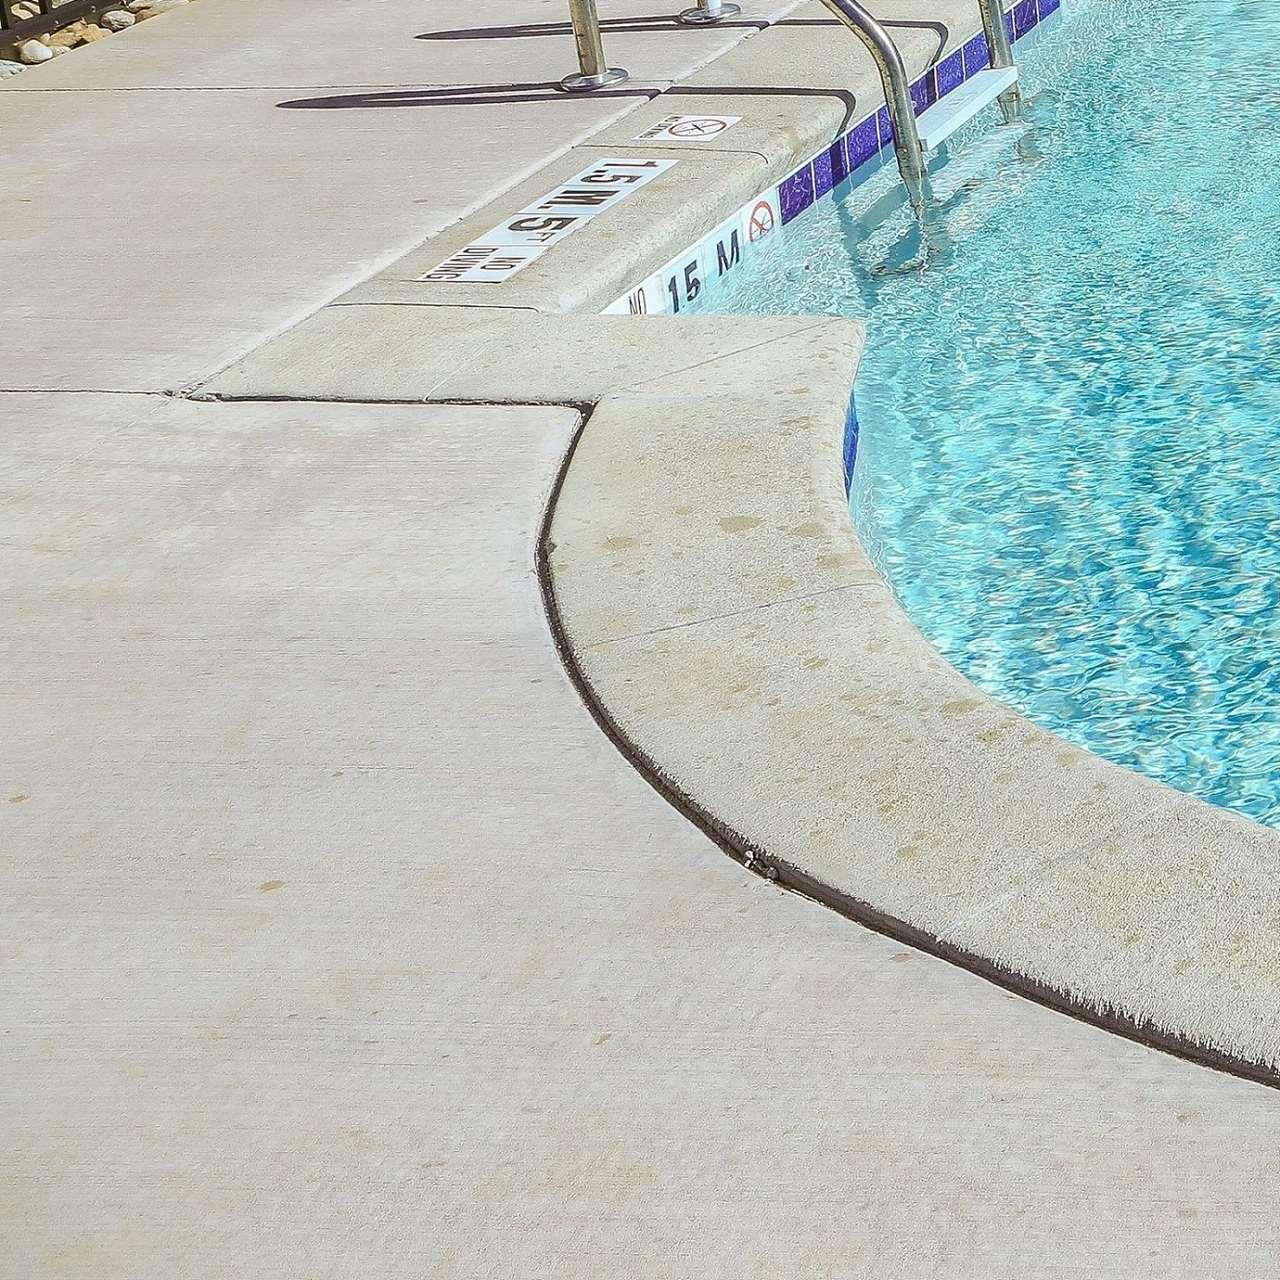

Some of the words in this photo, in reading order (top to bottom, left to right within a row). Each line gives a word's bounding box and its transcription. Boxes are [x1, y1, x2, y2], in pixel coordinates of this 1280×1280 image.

[580, 160, 659, 184] 1.5
[508, 216, 579, 232] 5
[424, 247, 499, 280] DIVING
[479, 256, 526, 271] NO
